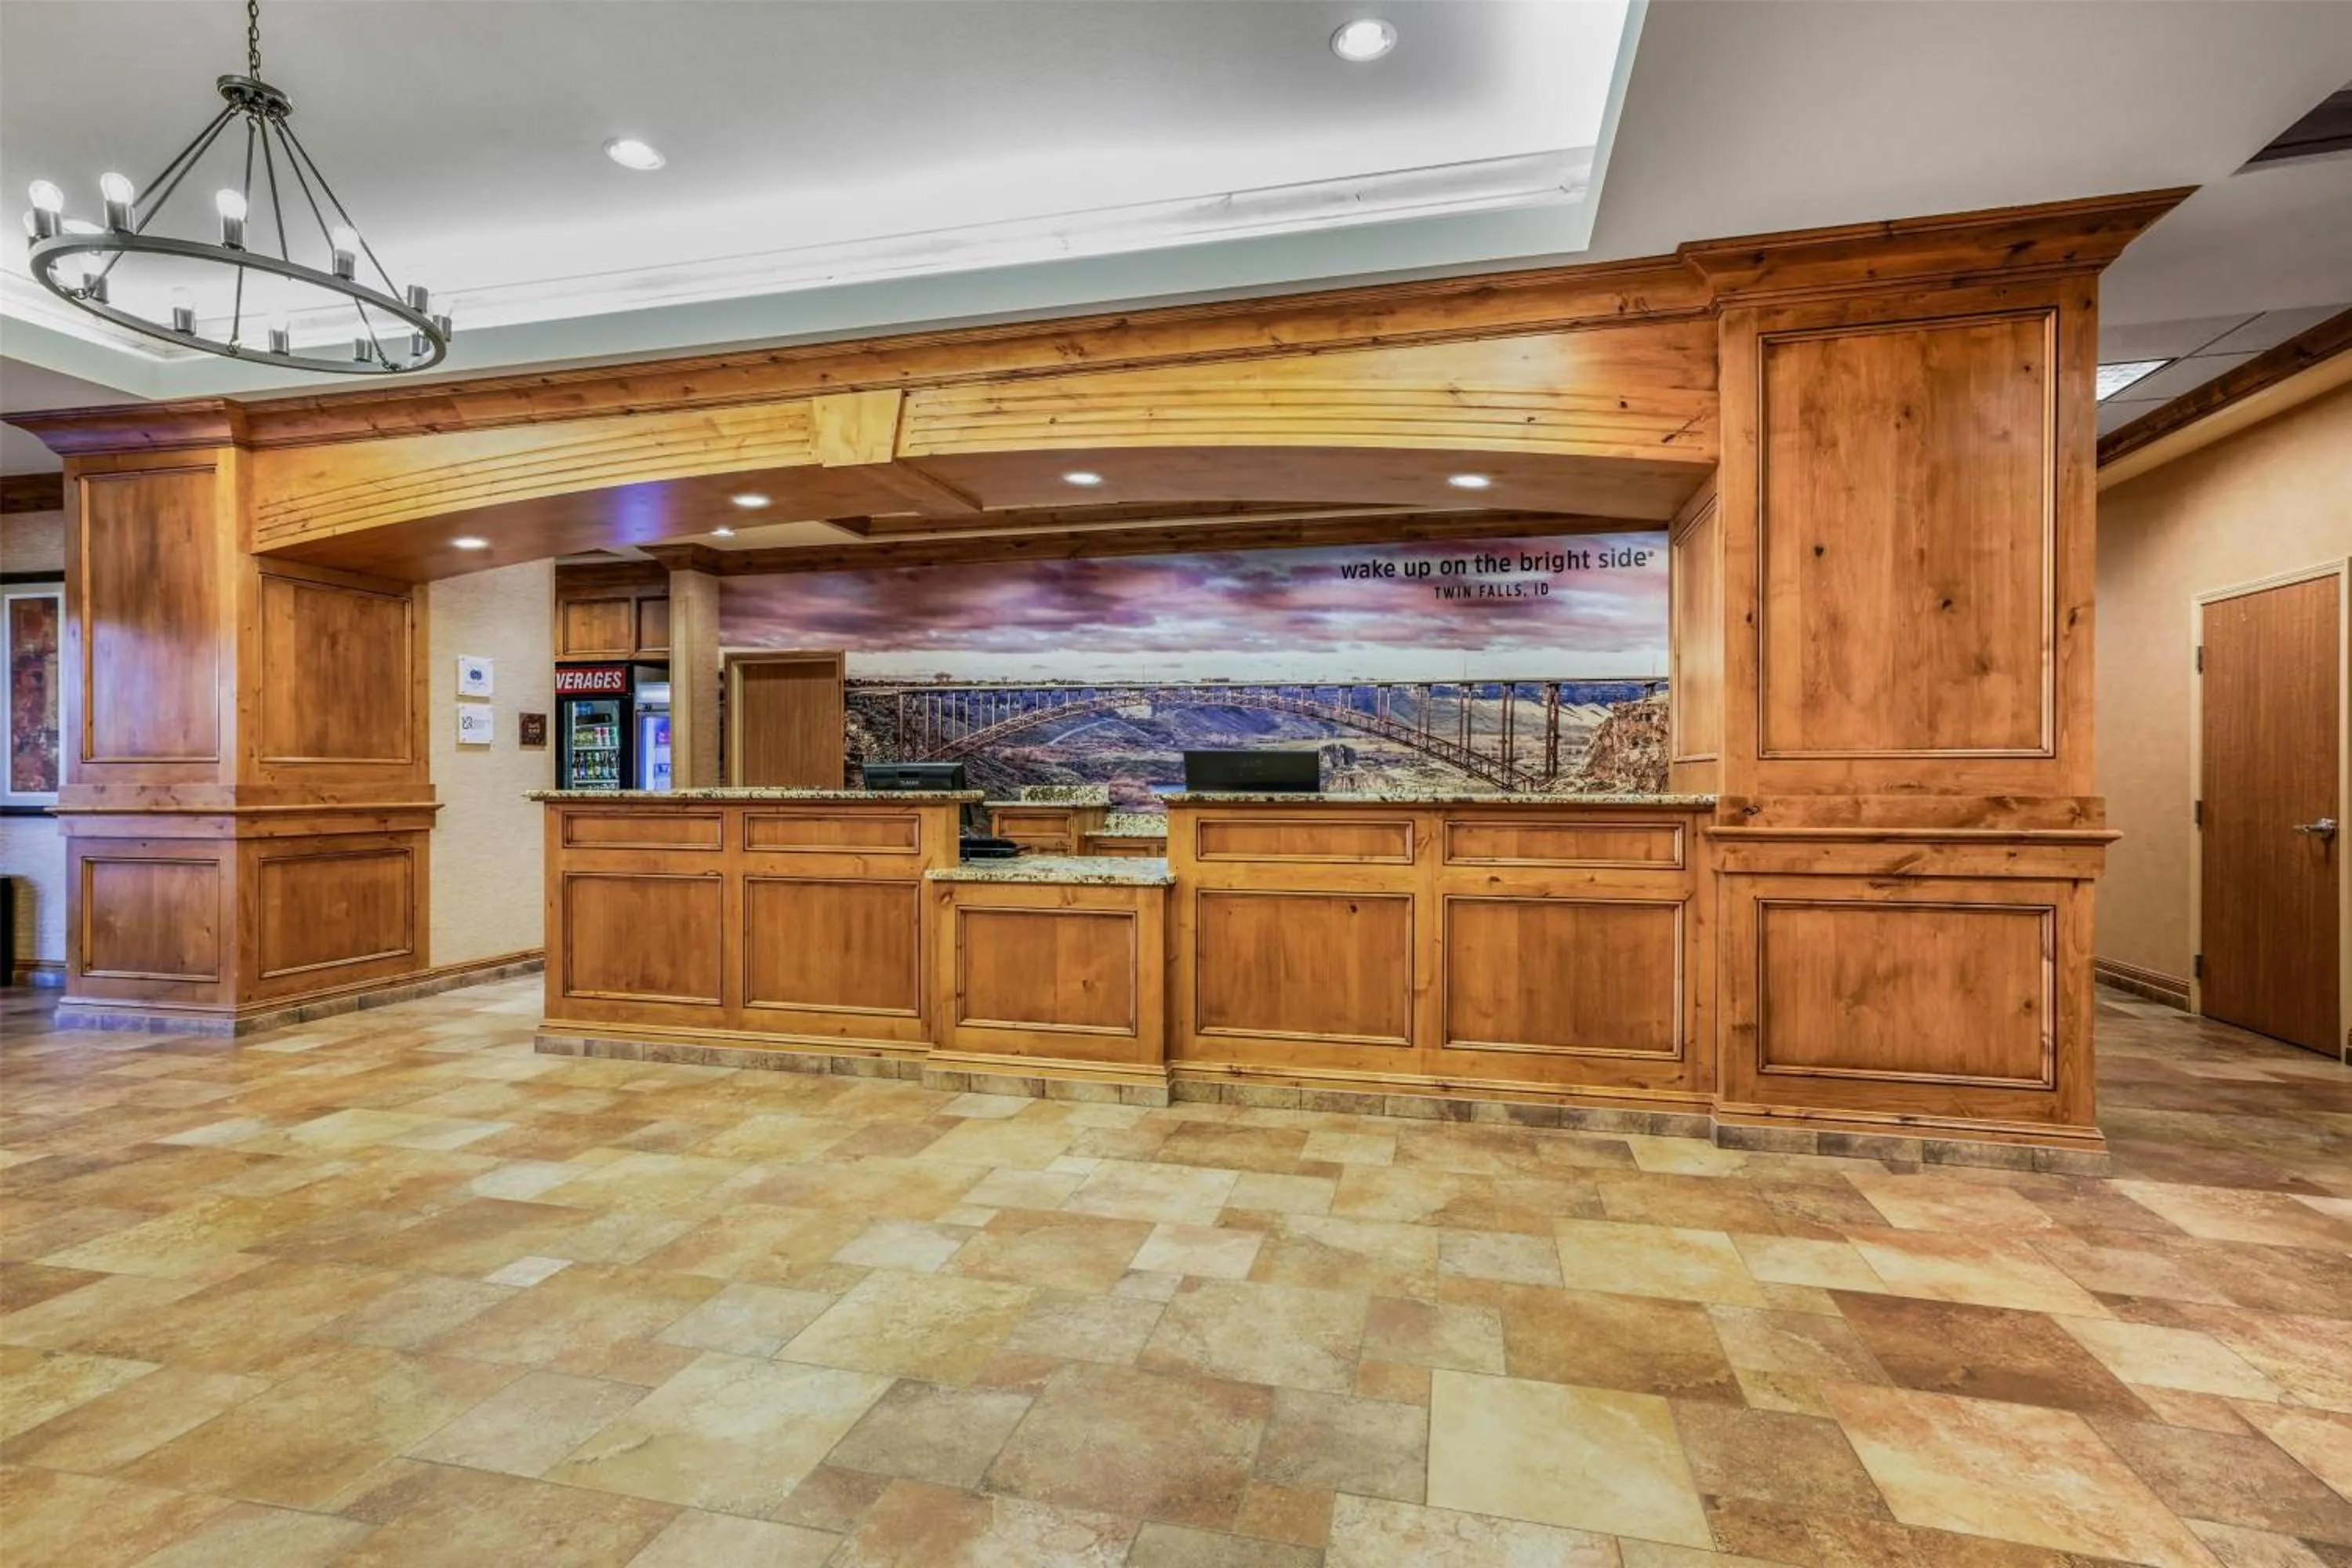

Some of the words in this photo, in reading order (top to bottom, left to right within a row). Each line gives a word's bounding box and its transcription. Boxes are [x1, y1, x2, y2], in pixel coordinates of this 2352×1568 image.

[1341, 559, 1396, 579] wake
[1405, 560, 1431, 579] up
[1440, 559, 1467, 575] on
[1475, 554, 1512, 574] the
[1520, 550, 1591, 573] bright
[1434, 586, 1472, 599] TWIN
[1479, 584, 1526, 597] FALLS,
[1534, 583, 1549, 595] ID
